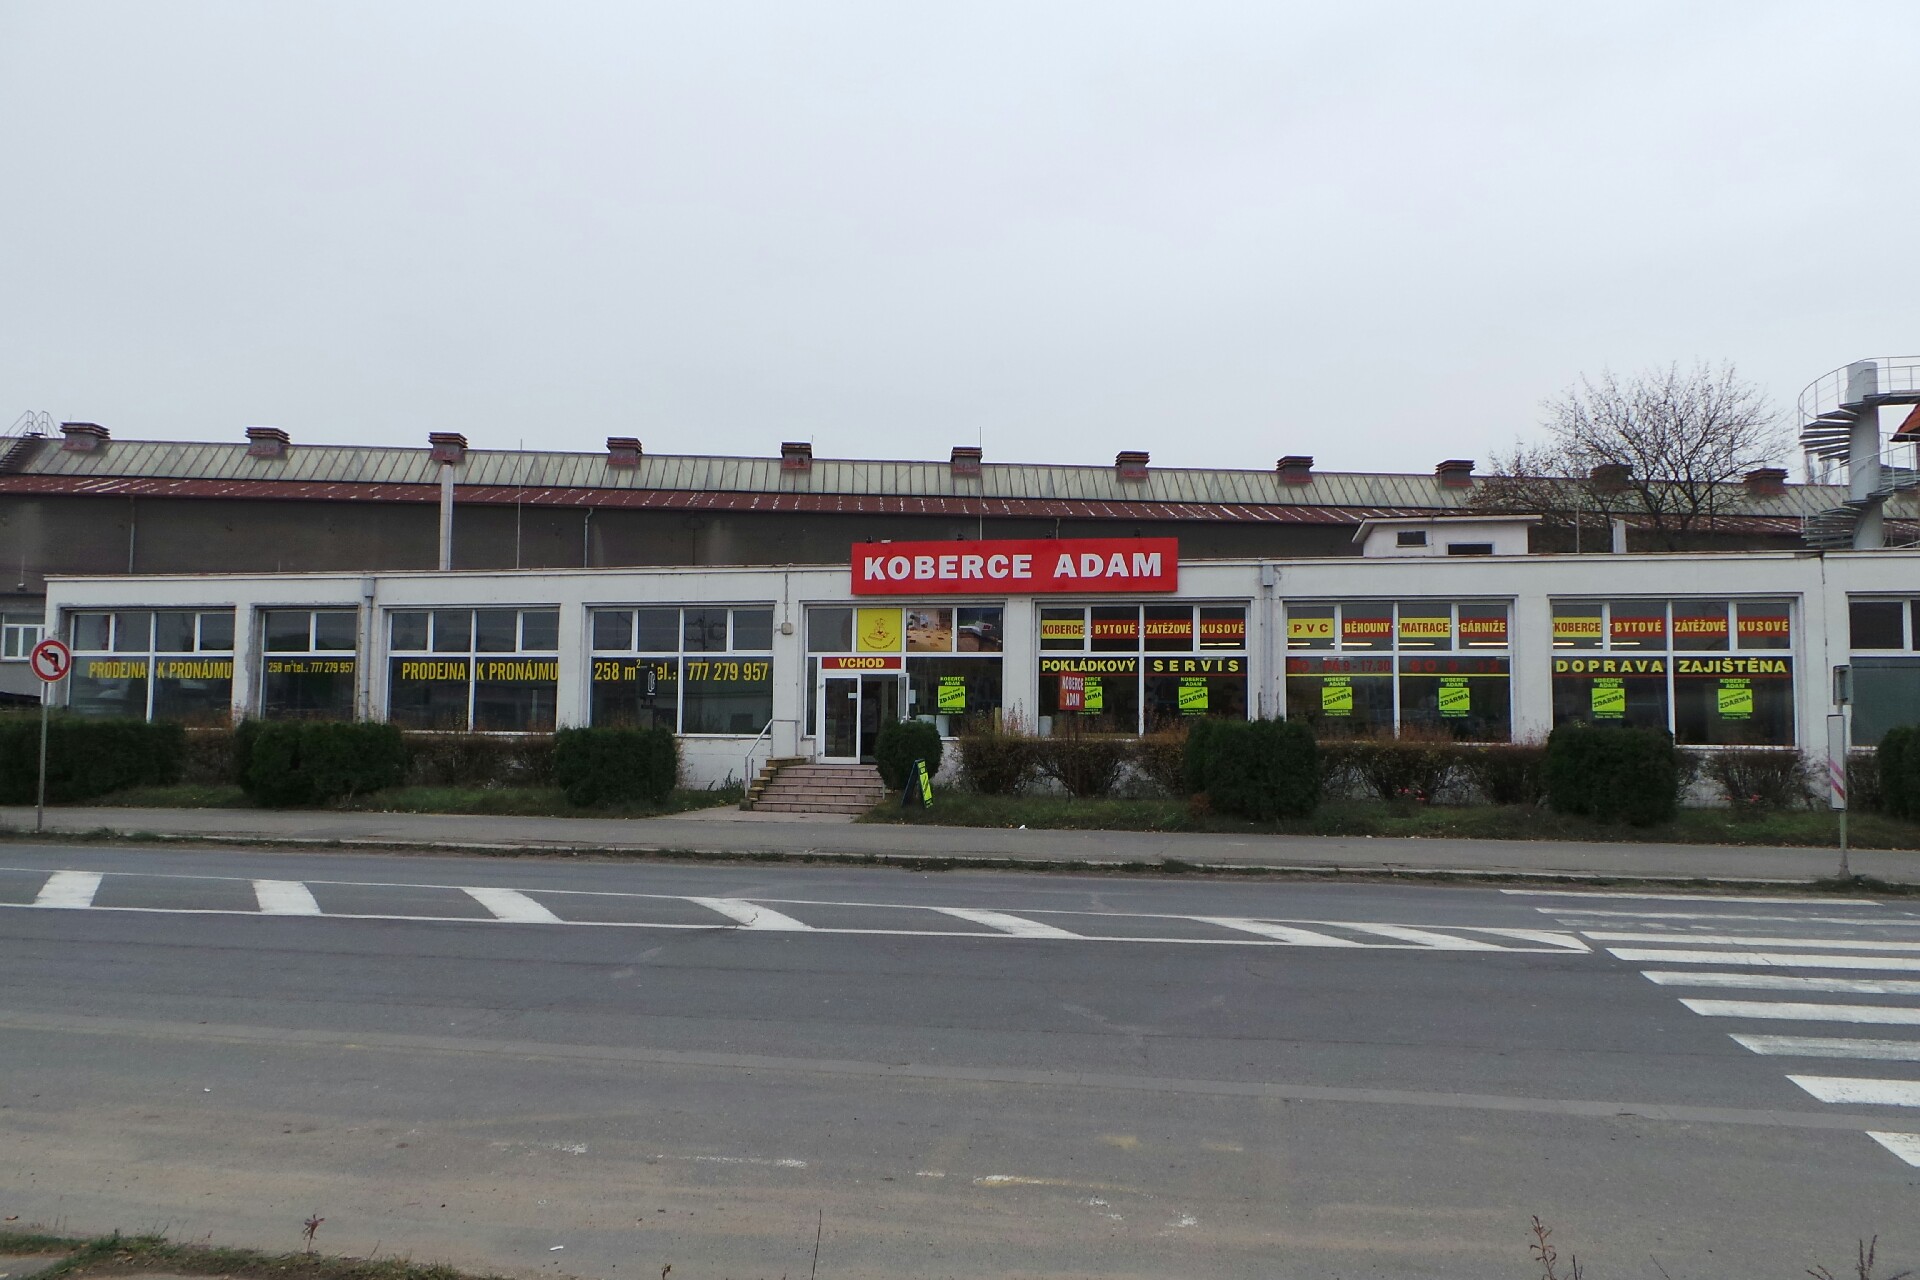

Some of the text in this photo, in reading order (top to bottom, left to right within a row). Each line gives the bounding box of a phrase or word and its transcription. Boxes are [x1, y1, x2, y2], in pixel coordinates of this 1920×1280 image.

[864, 551, 1163, 580] KOBERCE ADAM
[1042, 624, 1084, 635] KOBERCE
[1095, 621, 1136, 635] BYTOVÉ
[1146, 621, 1191, 635] ZÁTĚŽOVÉ
[1201, 621, 1245, 634] KUSOVÉ
[1345, 620, 1390, 633] BĚHOUNY
[1402, 622, 1449, 633] MATRACE
[1460, 619, 1506, 633] GÁRNIŽE
[1554, 622, 1601, 632] KOBERCE
[1614, 619, 1662, 632] BYTOVÉ
[1674, 618, 1727, 632] ZÁTĚŽOVÉ
[1738, 618, 1789, 632] KUSOVÉ
[89, 659, 233, 680] PRODEJNA K PRONÁJMU
[268, 661, 282, 673] 258
[310, 662, 324, 673] 777
[324, 662, 338, 673] 279
[340, 662, 354, 673] 957
[402, 659, 558, 681] PRODEJNA K PRONÁJMU
[838, 657, 885, 669] VCHOD
[1042, 657, 1239, 672] POKLÁDKOVÝ SERVIS
[1556, 657, 1787, 673] DOPRAVA ZAJIŠTĚNA
[594, 663, 620, 680] 258
[688, 663, 709, 680] 777
[714, 663, 739, 680] 279
[743, 663, 768, 680] 957
[1061, 676, 1084, 691] KOBERCE
[939, 692, 965, 704] ZDARMA
[1066, 692, 1080, 706] ADAM
[1180, 693, 1207, 705] ZDARMA
[1323, 693, 1351, 706] ZDARMA
[1440, 693, 1469, 706] ZDARMA
[1593, 695, 1624, 708] ZDARMA
[1719, 695, 1751, 709] ZDARMA
